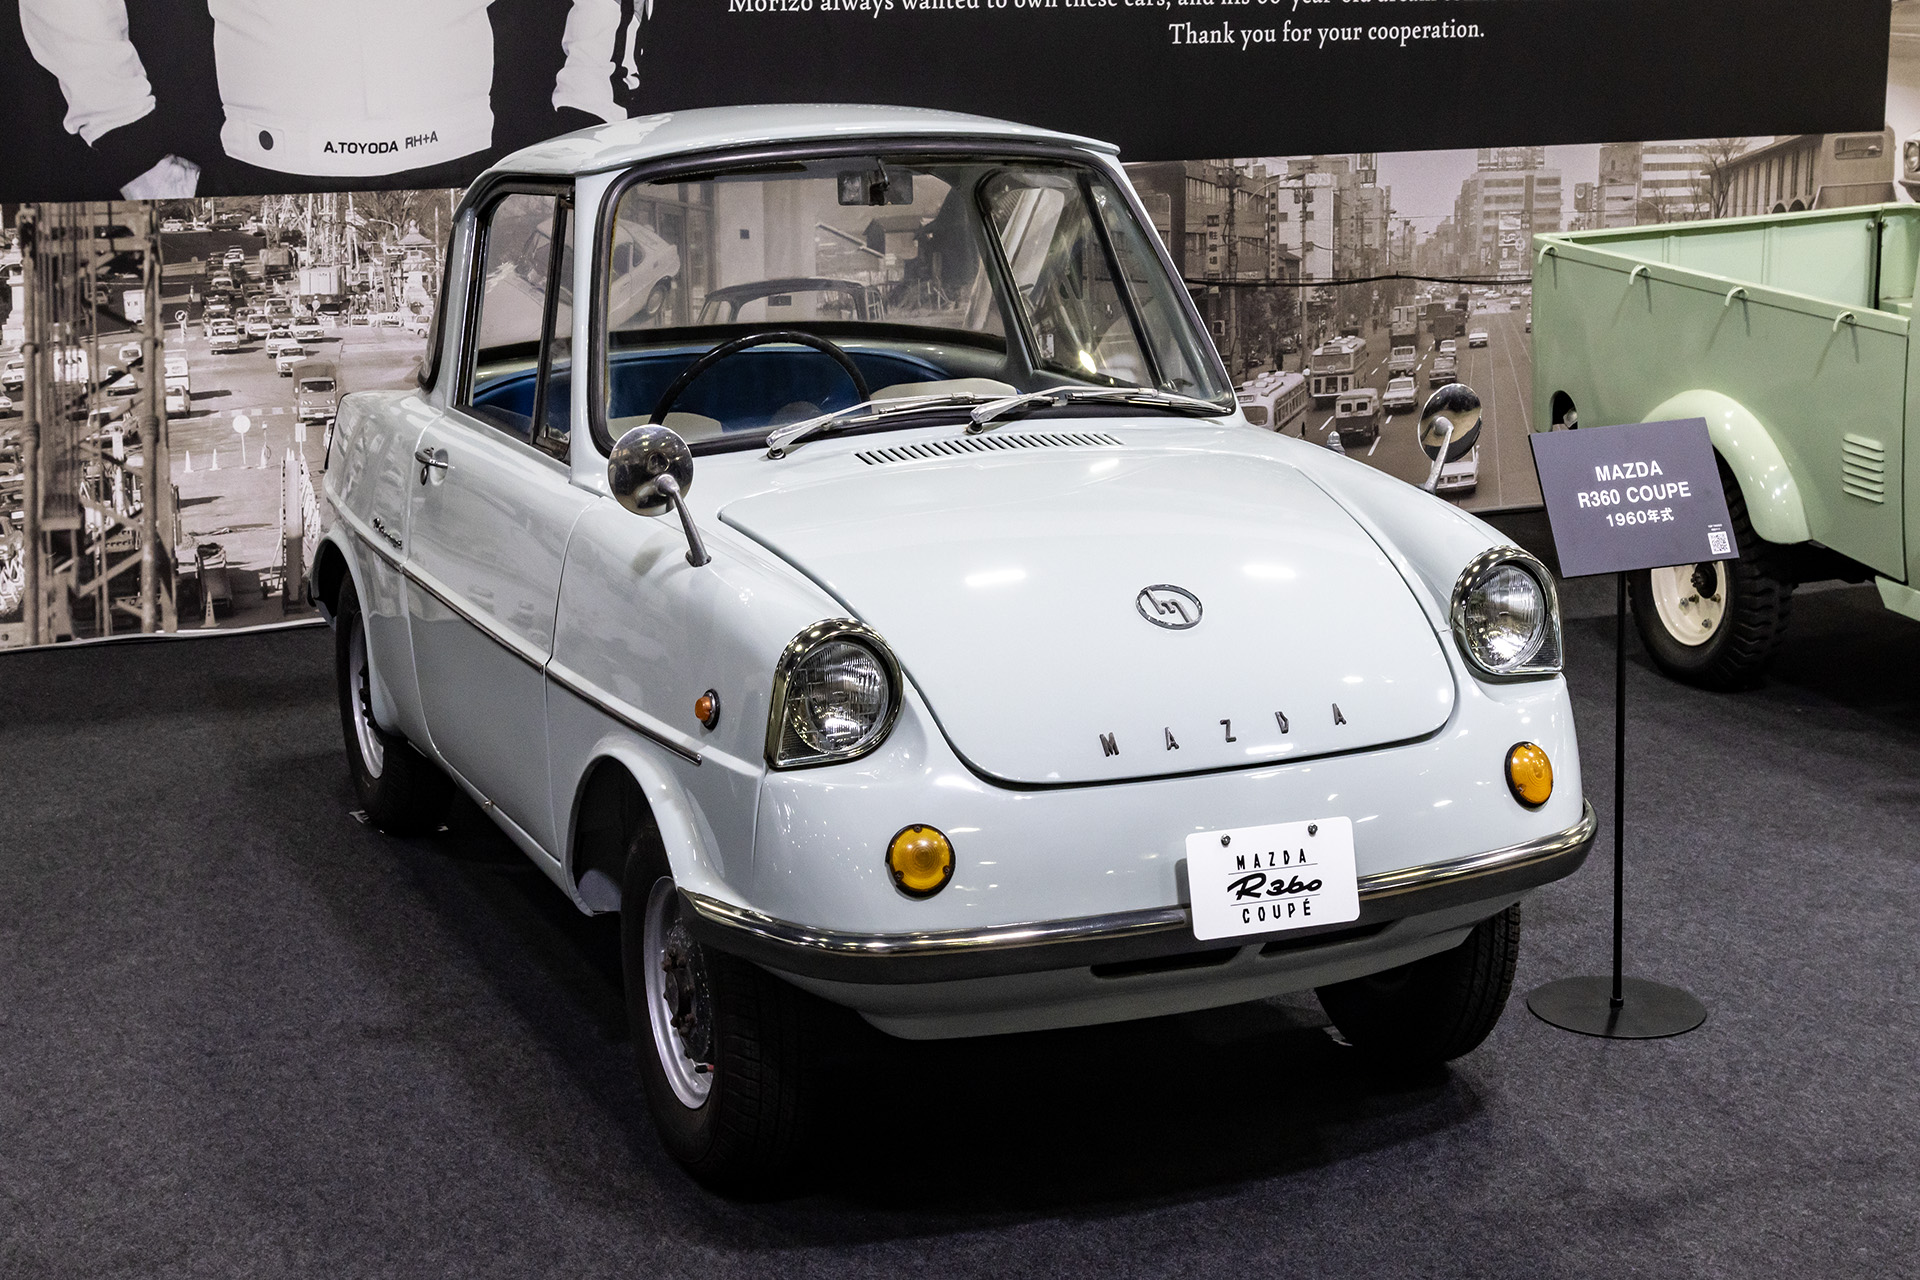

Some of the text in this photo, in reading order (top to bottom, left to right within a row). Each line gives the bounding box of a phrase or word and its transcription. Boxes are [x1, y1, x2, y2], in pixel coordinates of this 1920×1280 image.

[727, 0, 813, 12] Morizo
[1168, 18, 1485, 51] Thank you for your cooperation.
[323, 130, 439, 155] A.TOYODA RH+A
[1594, 460, 1664, 482] MAZDA
[1577, 481, 1692, 509] R360 COUPE
[1605, 507, 1675, 527] 1960年式
[1099, 702, 1347, 758] MAZDA
[1236, 848, 1307, 871] MAZDA
[1226, 872, 1323, 901] R360
[1241, 898, 1312, 924] COUPÉ
